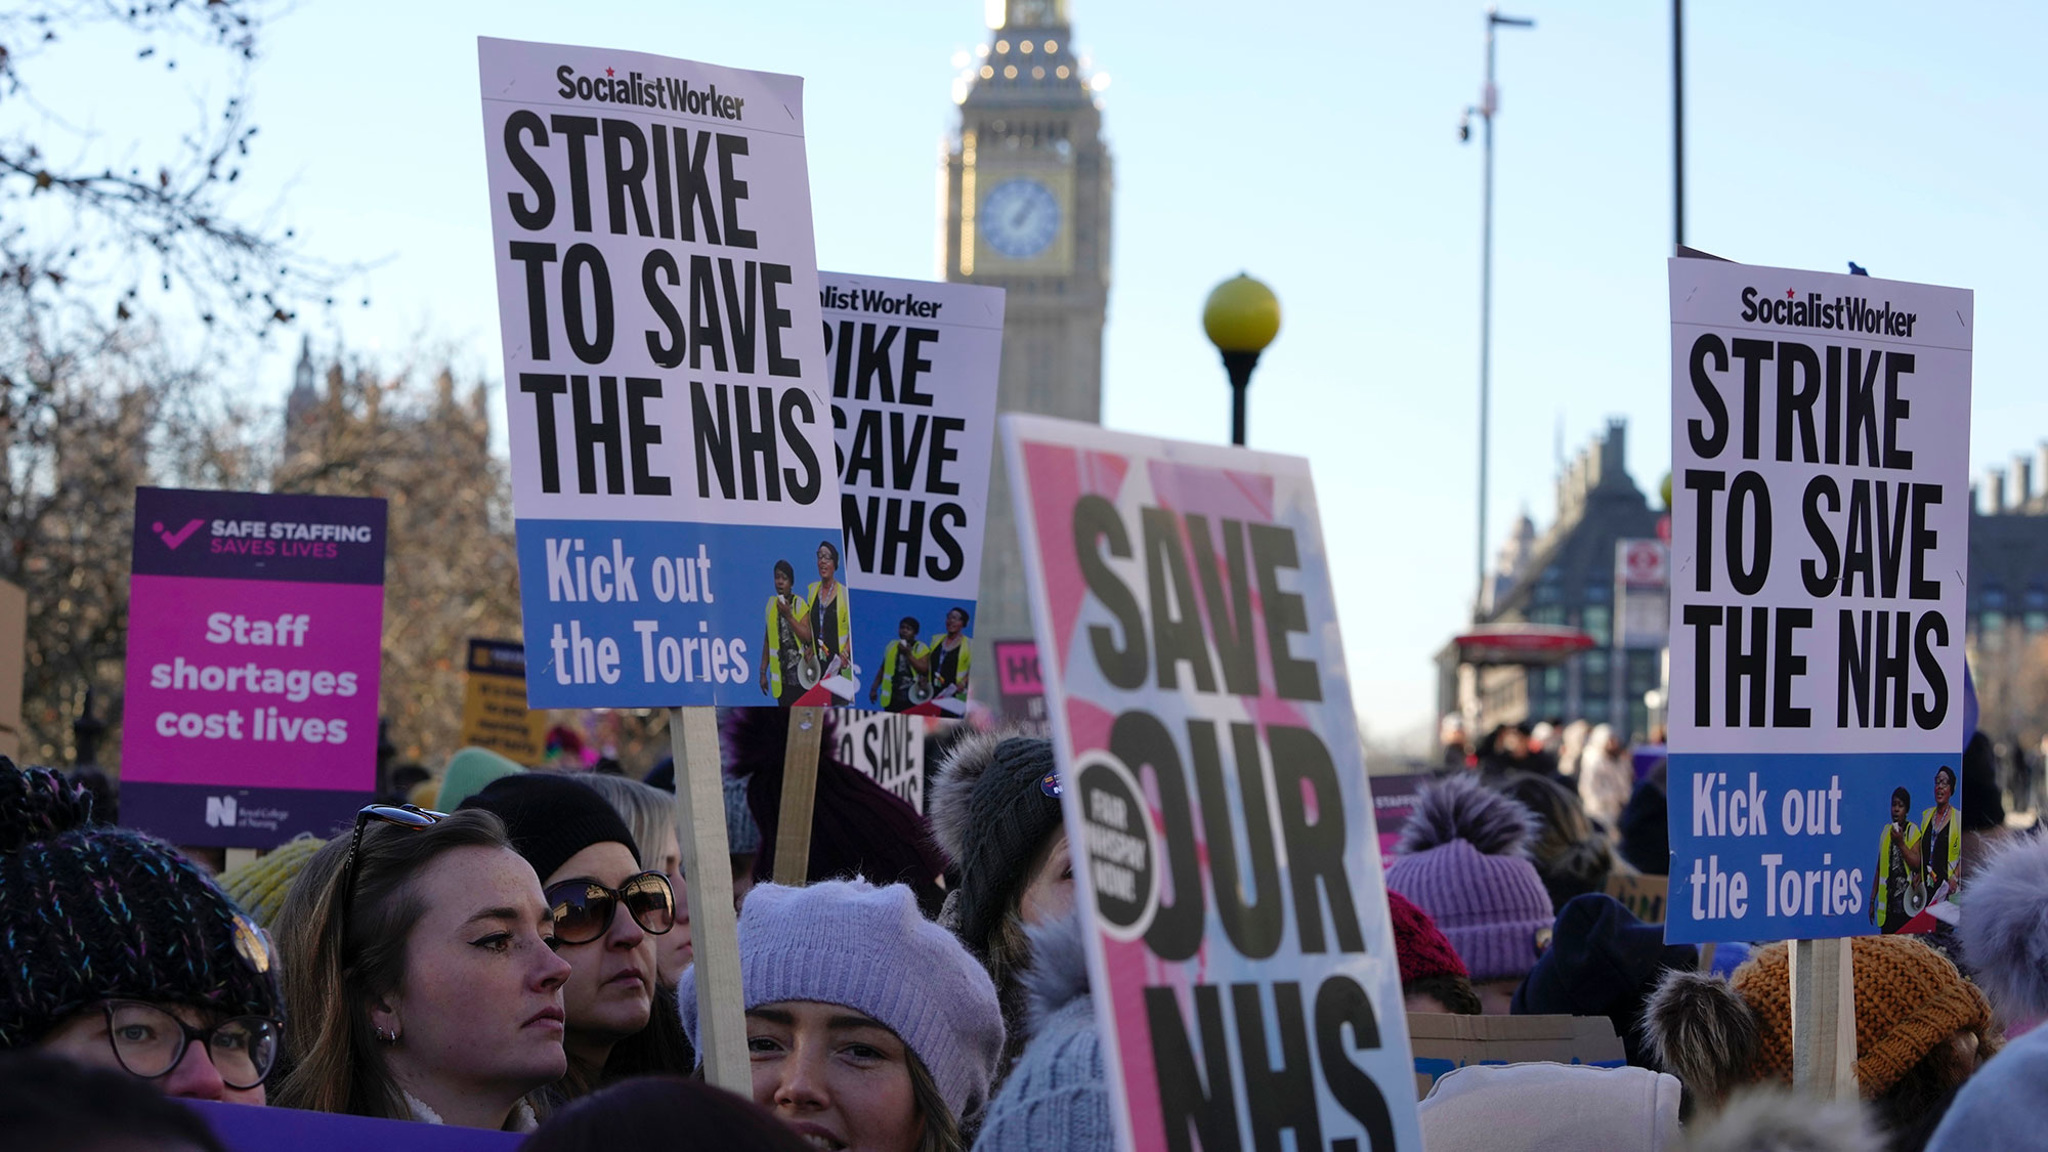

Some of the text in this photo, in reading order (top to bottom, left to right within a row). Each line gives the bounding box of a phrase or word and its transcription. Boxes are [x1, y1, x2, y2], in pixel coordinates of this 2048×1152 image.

[504, 110, 757, 249] STRIKE
[510, 241, 801, 377] TO SAVE
[824, 321, 939, 406] IKE
[1688, 334, 1915, 470] STRIKE
[520, 373, 821, 505] THE NHS
[210, 538, 338, 559] SAVES LIVES
[211, 519, 371, 543] SAFE STAFFING
[546, 538, 713, 603] Kick out
[841, 493, 966, 582] NHS
[1685, 469, 1942, 600] TO SAVE
[205, 612, 310, 647] Staff
[1072, 494, 1323, 703] SAVE
[150, 657, 358, 702] shortages
[551, 620, 748, 685] the Tories
[1684, 605, 1948, 730] THE NHS
[155, 706, 348, 744] cost lives
[262, 808, 289, 821] College
[1107, 710, 1366, 962] OUR
[1693, 773, 1841, 836] Kick out
[1690, 856, 1747, 920] the
[1761, 854, 1862, 917] Tories
[1141, 975, 1397, 1152] NHS
